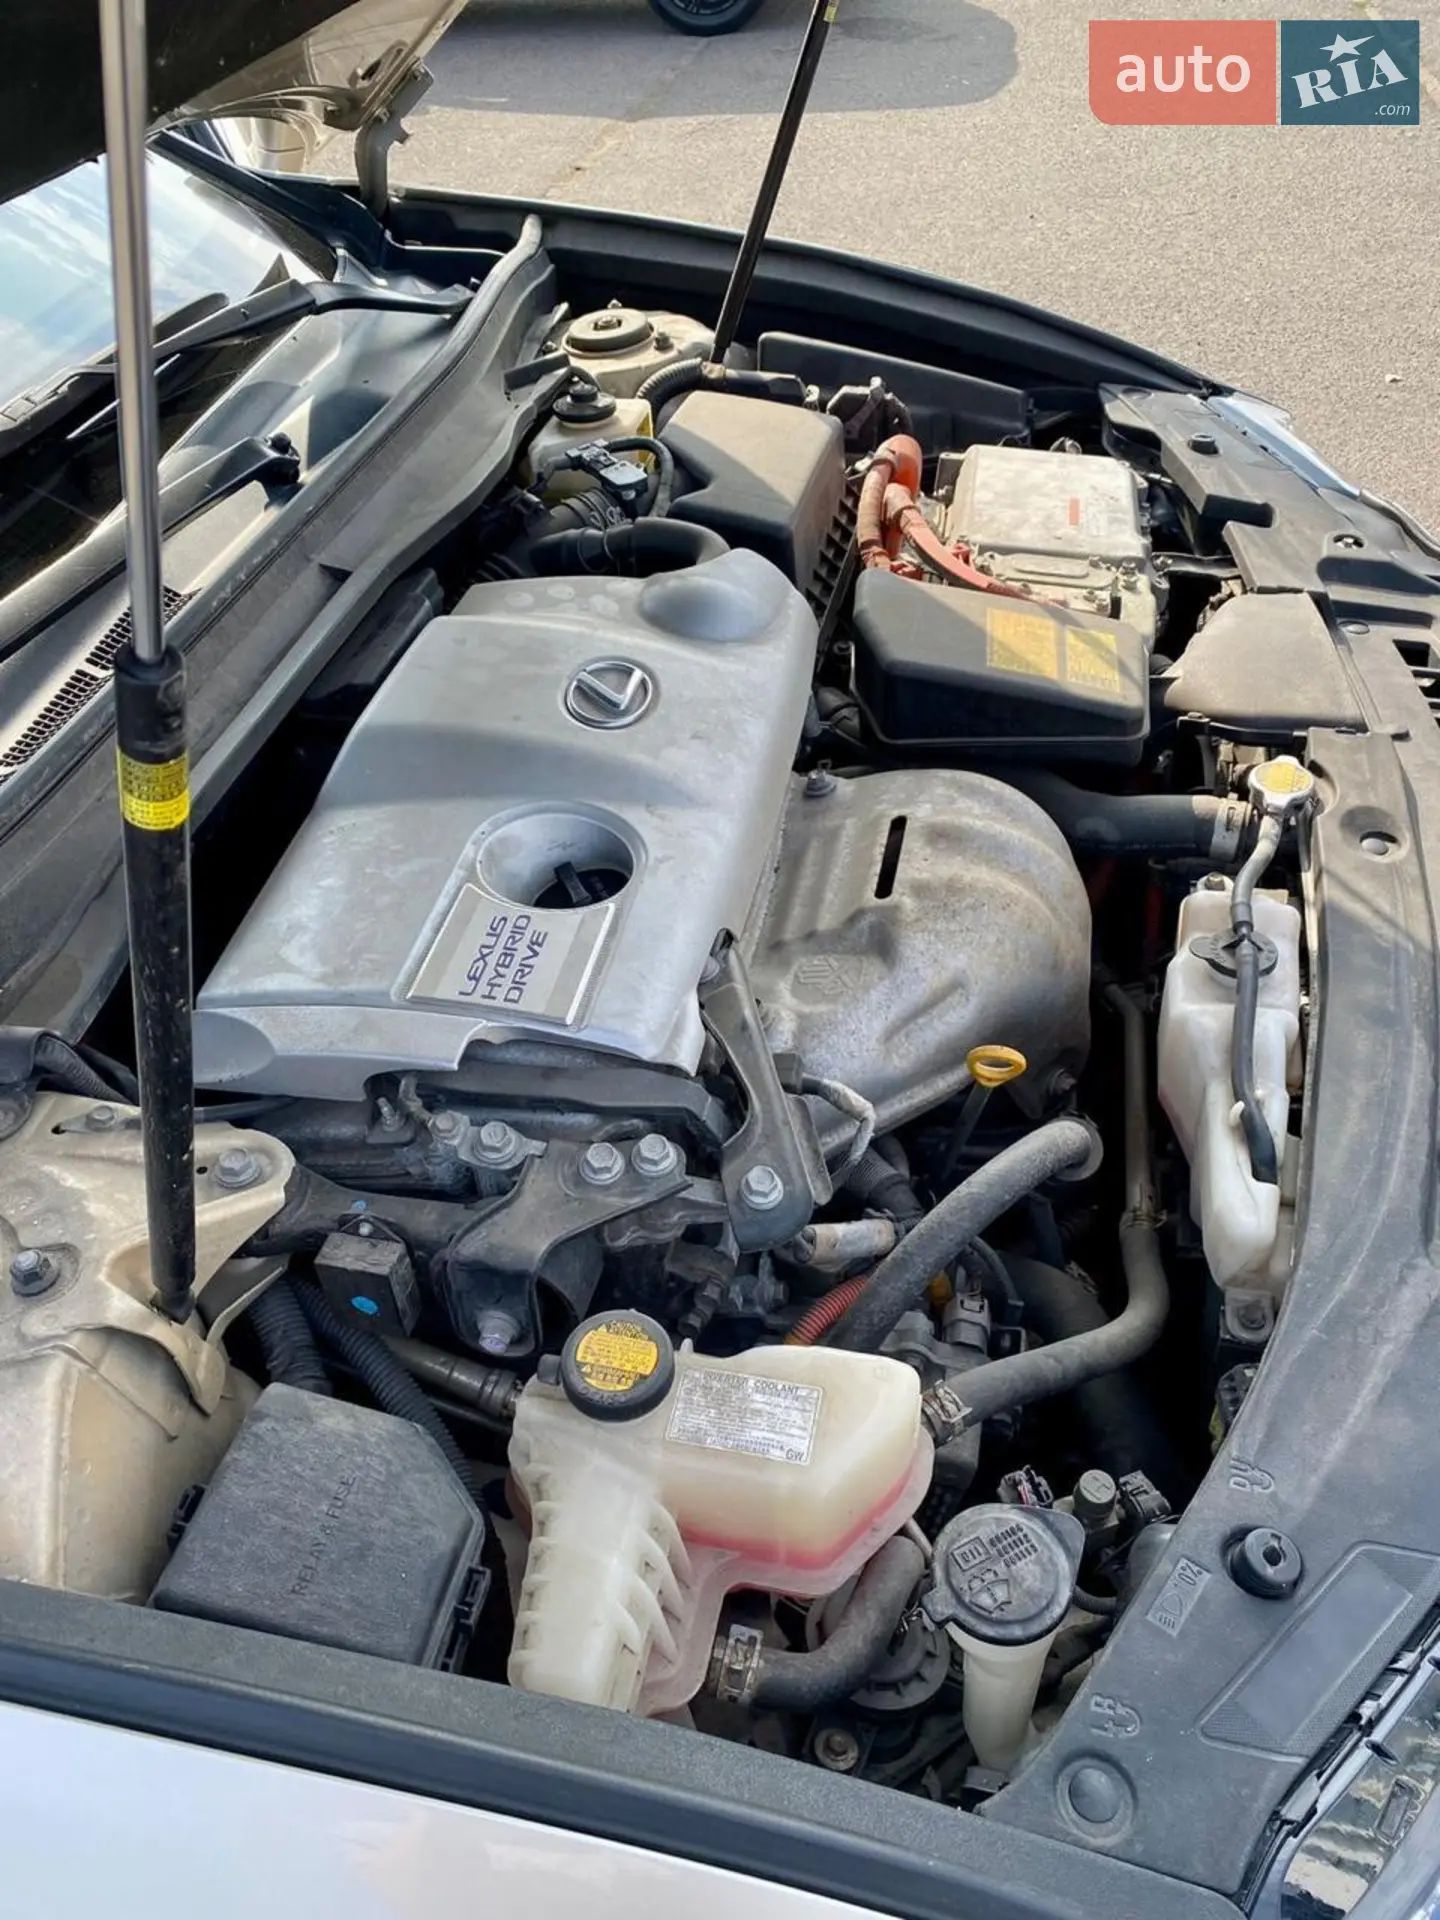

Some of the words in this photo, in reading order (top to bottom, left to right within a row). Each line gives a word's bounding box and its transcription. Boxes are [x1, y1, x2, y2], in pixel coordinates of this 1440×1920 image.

[459, 915, 508, 997] LEXUS
[481, 914, 532, 1001] HYBRID
[503, 929, 548, 1004] DRIVE
[754, 1379, 801, 1395] COOLANT
[290, 1537, 327, 1597] RELAY
[325, 1474, 357, 1520] FUSE
